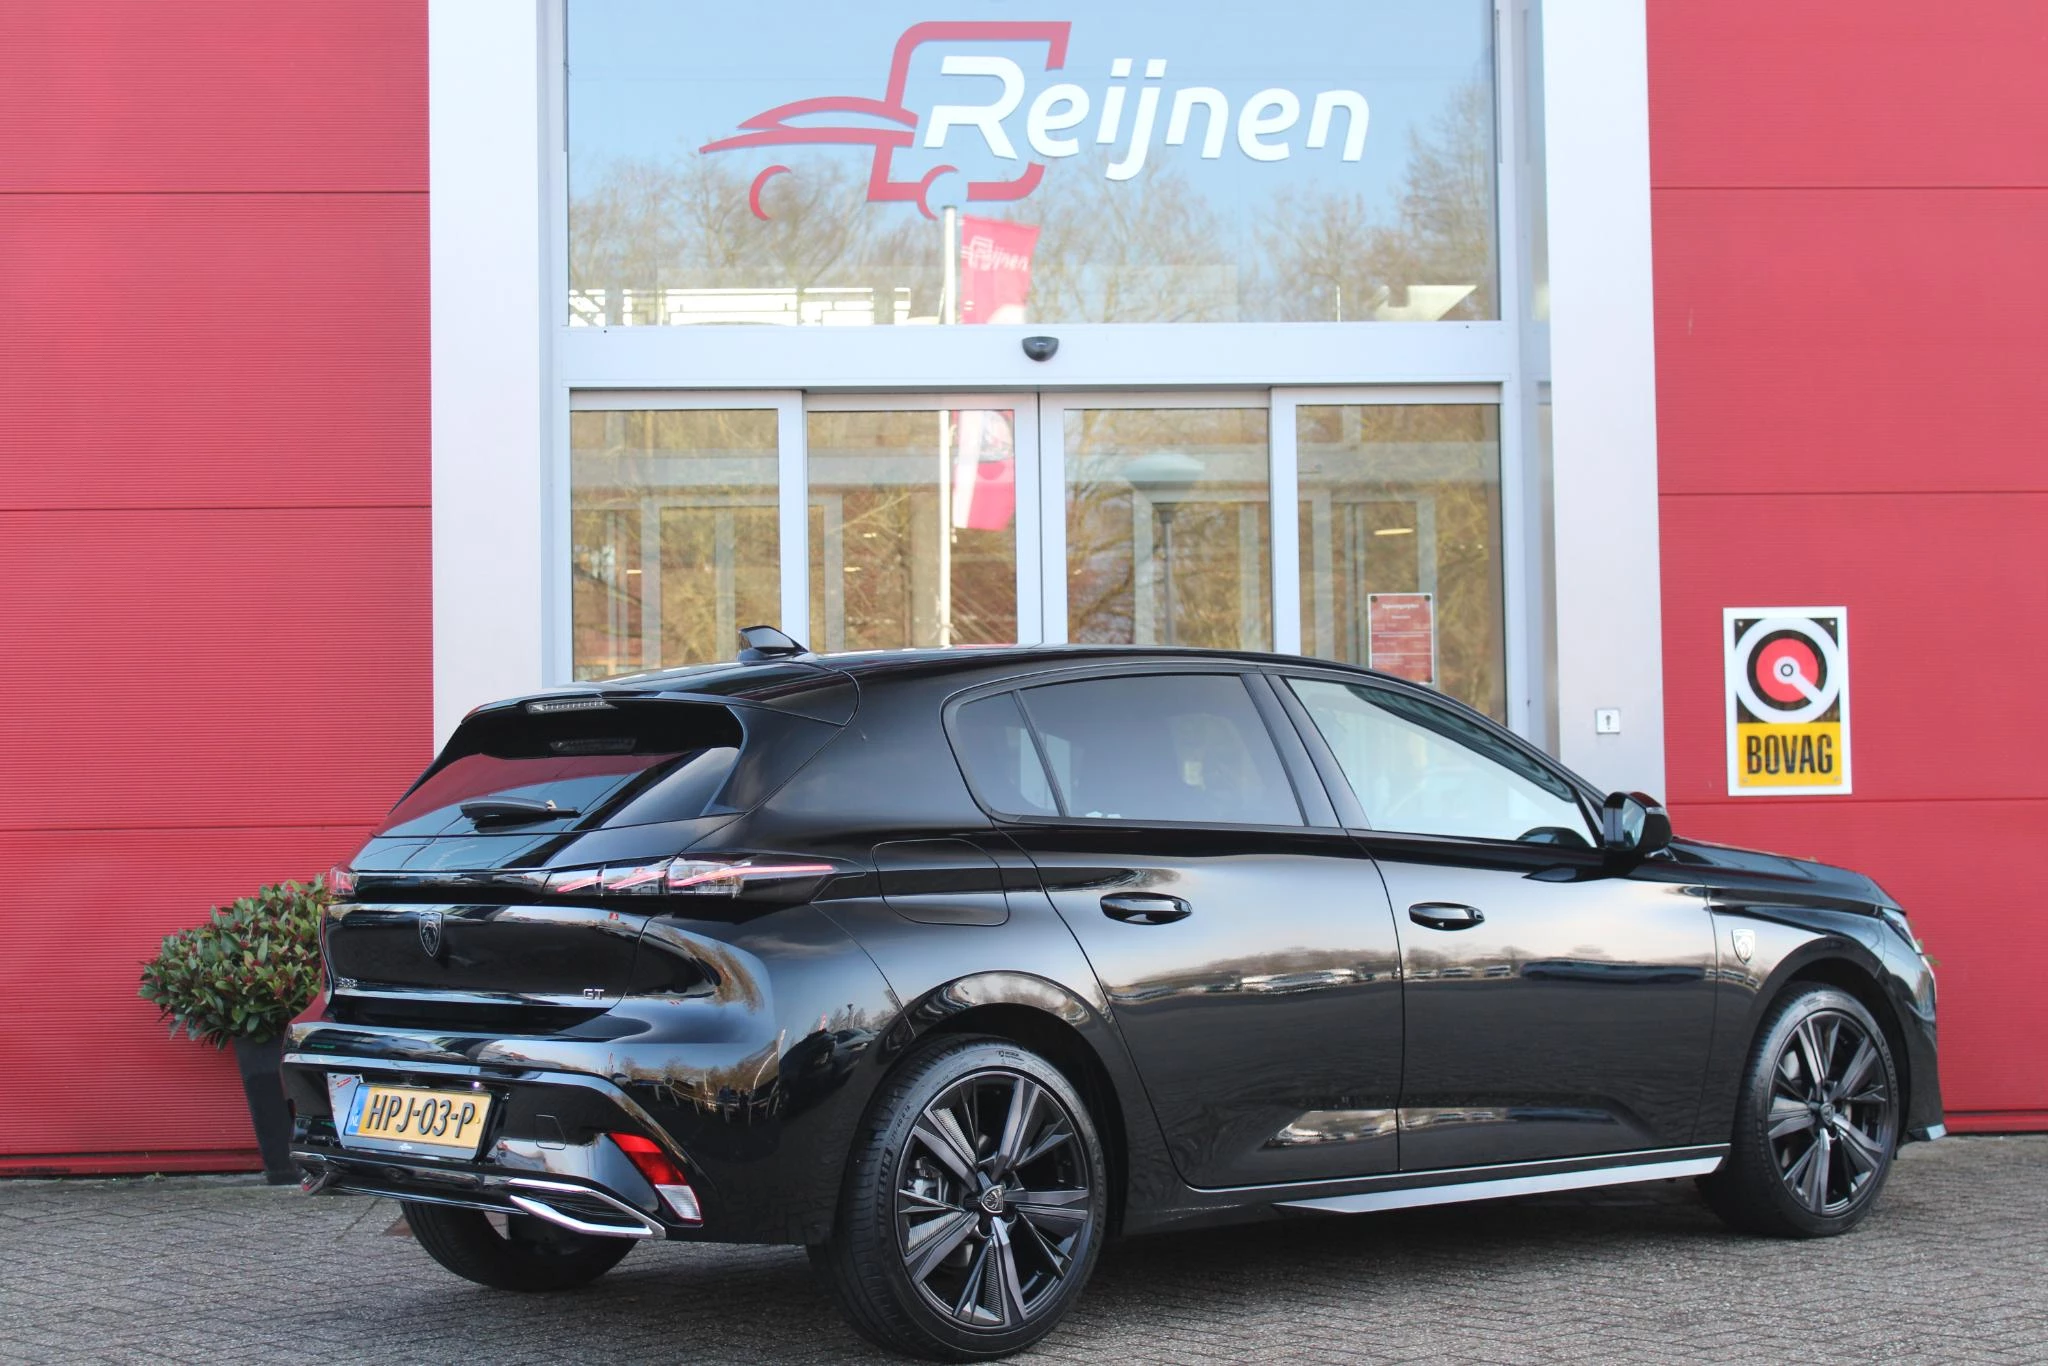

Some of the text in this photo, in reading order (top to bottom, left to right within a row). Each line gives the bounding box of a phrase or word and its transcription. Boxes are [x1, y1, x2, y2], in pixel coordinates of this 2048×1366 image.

[923, 56, 1370, 181] Reijnen
[1746, 734, 1833, 774] BOVAG
[583, 988, 605, 1000] GT
[366, 1094, 476, 1139] HPJ-03-P
